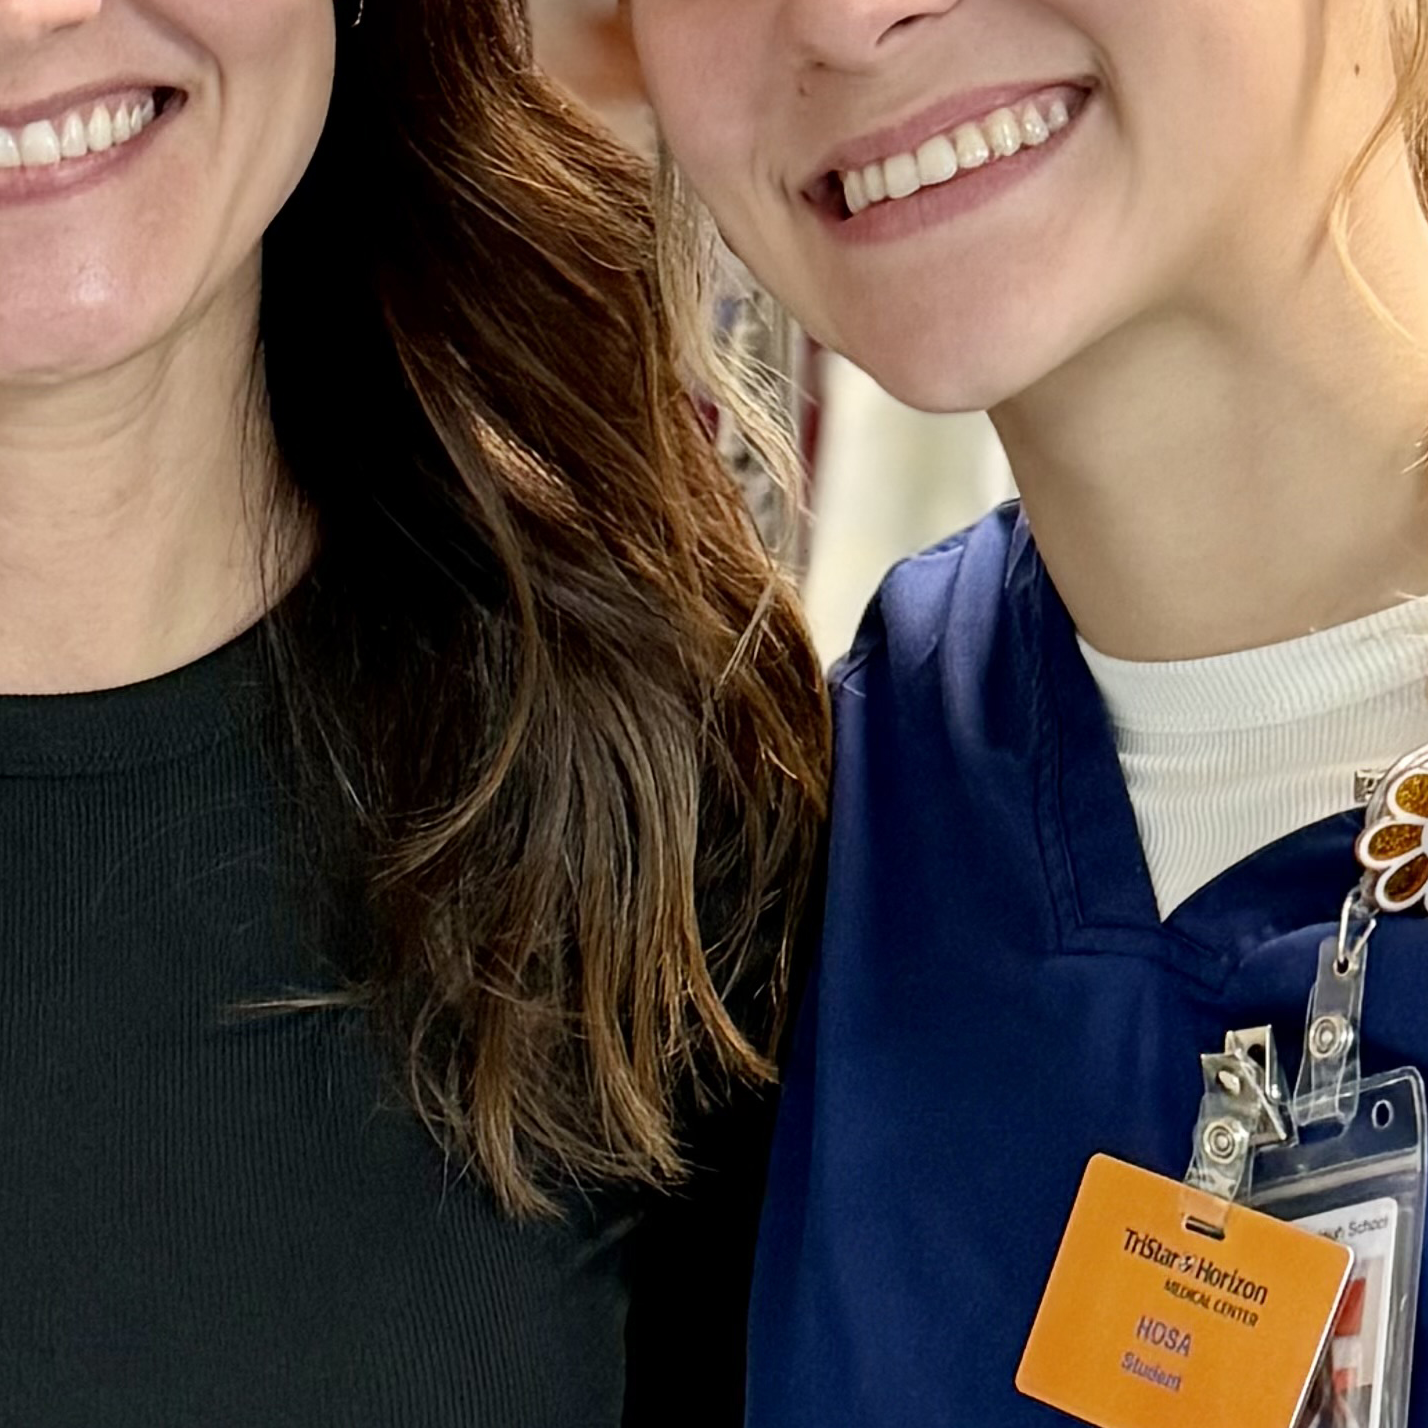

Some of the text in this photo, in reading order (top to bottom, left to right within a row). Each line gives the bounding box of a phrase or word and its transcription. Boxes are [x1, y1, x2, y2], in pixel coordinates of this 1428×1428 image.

[1123, 1227, 1268, 1306] TriStar Horizon
[1164, 1278, 1260, 1328] MEDICAL CENTER
[1136, 1314, 1193, 1358] HOSA
[1121, 1350, 1183, 1393] Student
